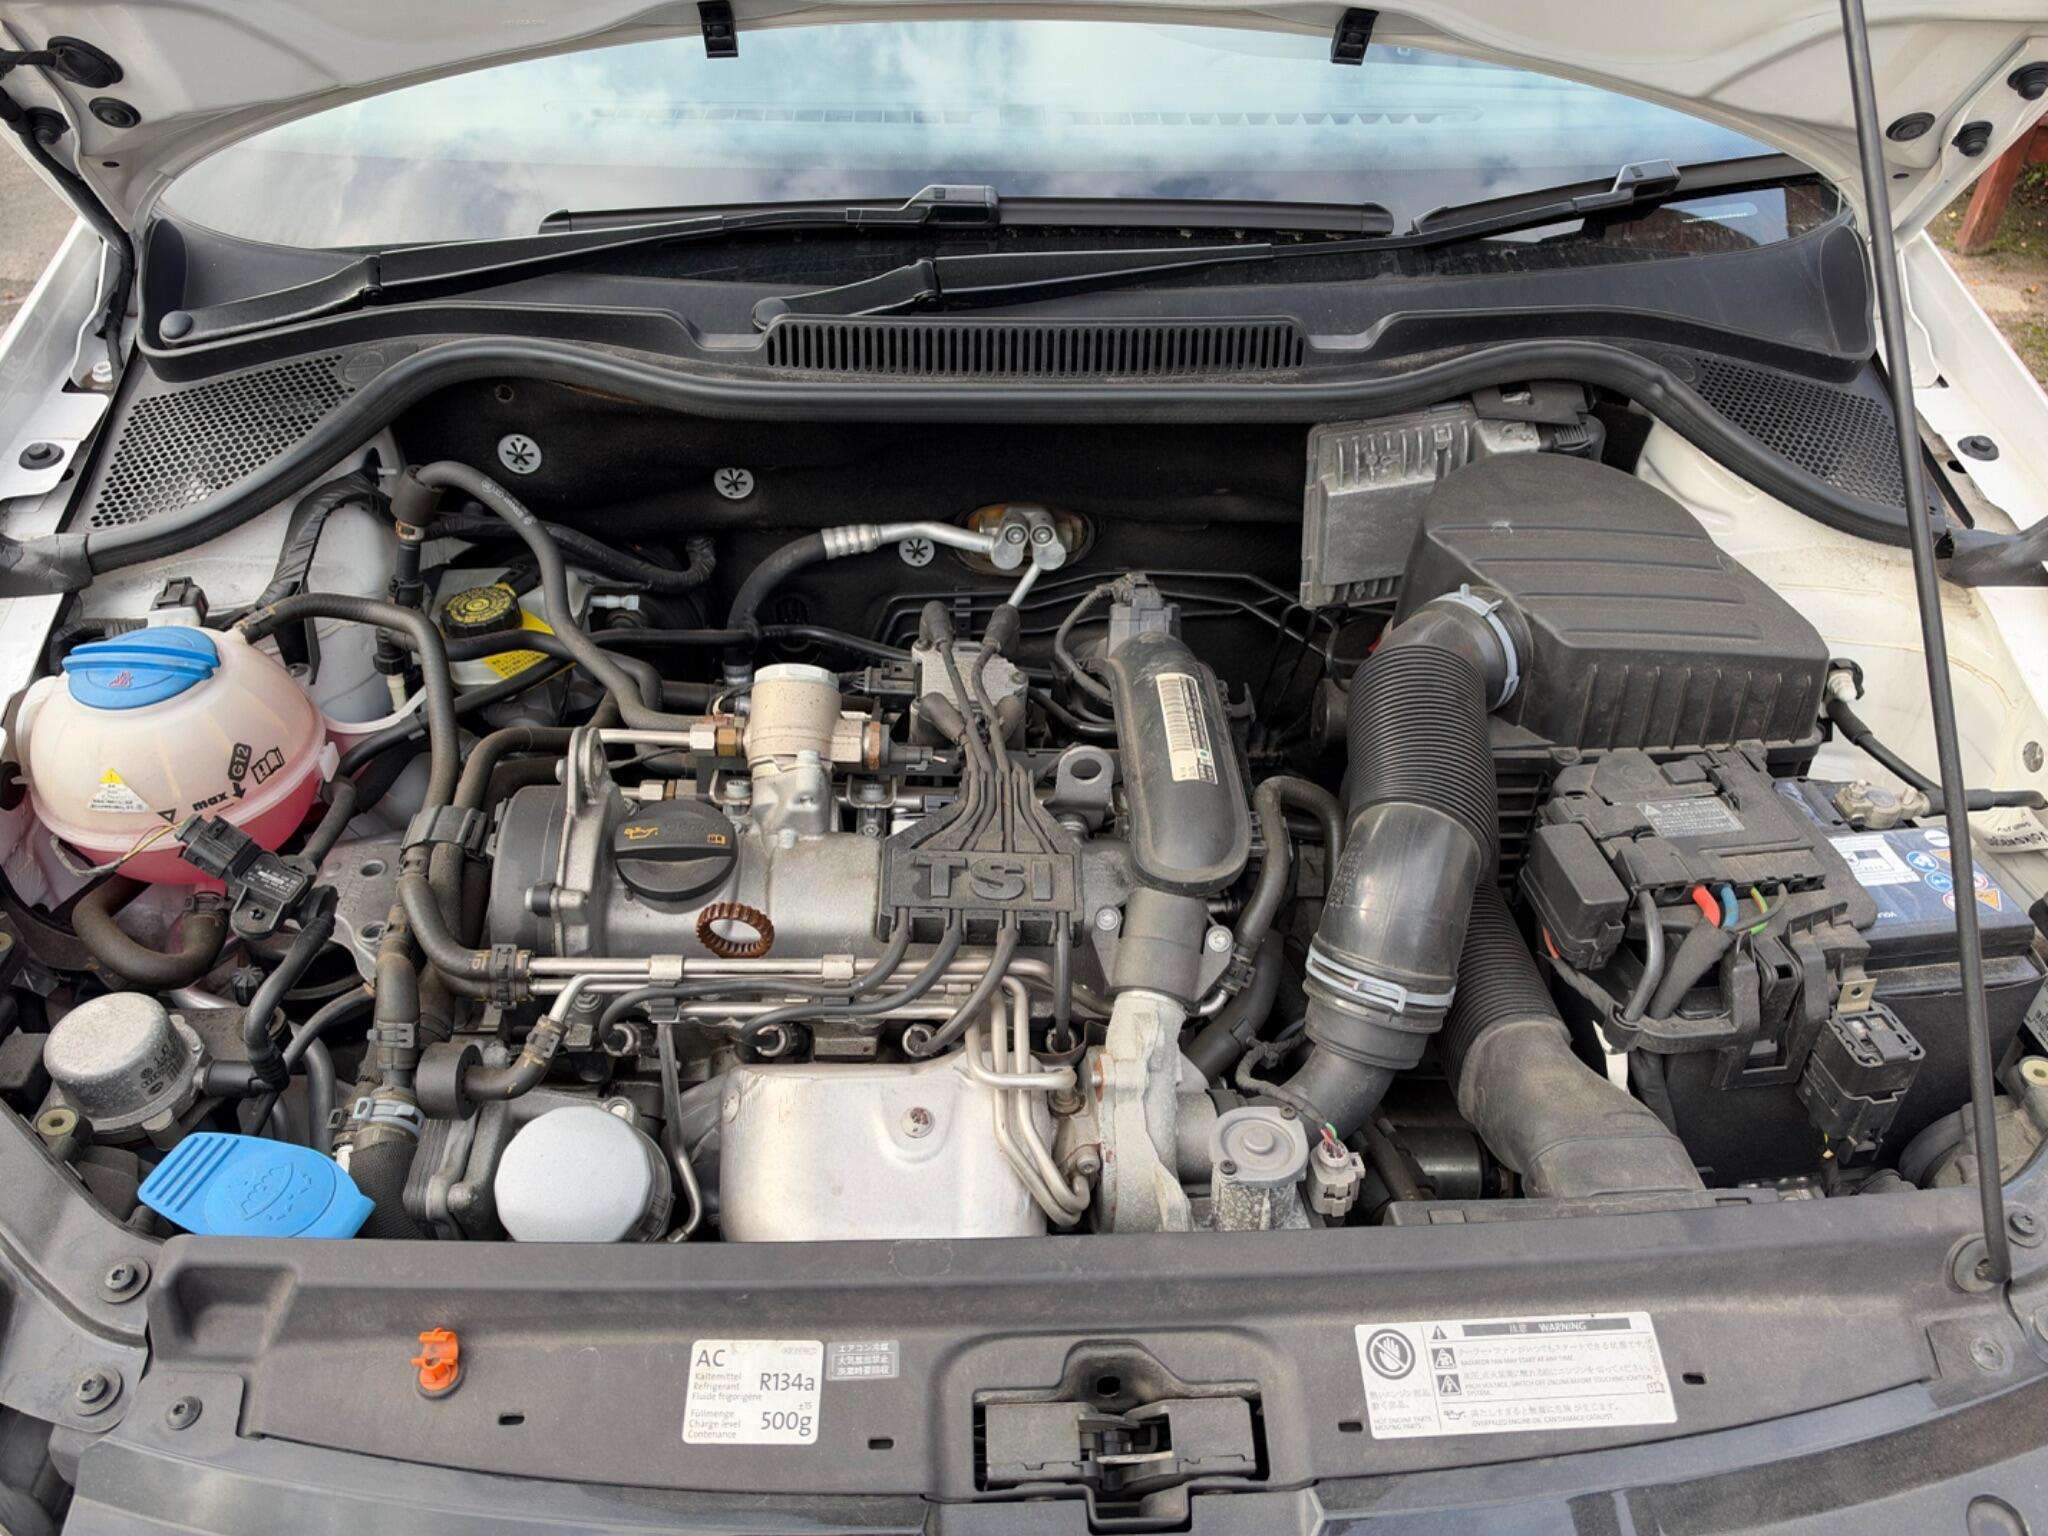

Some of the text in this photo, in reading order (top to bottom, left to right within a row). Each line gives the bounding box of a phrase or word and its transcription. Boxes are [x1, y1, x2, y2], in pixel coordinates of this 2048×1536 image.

[231, 746, 249, 778] G12
[191, 791, 229, 812] max
[913, 855, 1052, 900] TSI
[1538, 1321, 1587, 1333] WARNING
[695, 1348, 726, 1368] AC
[694, 1382, 740, 1392] Refrigerant
[760, 1372, 815, 1391] R134a
[688, 1419, 741, 1430] Charge level
[760, 1411, 812, 1436] 500g
[688, 1430, 737, 1439] Contenance
